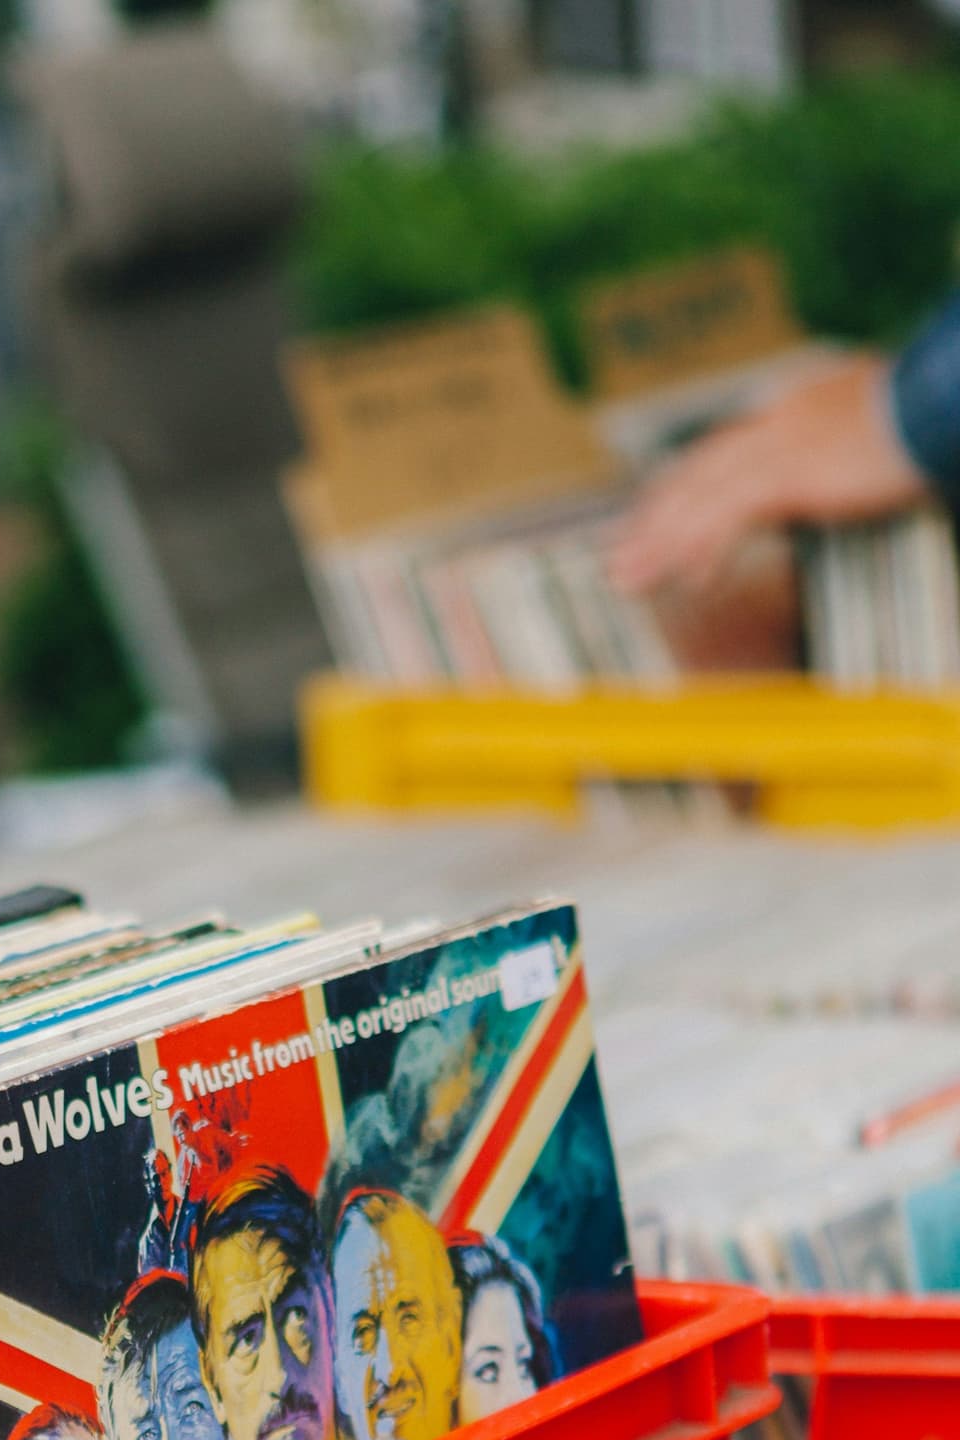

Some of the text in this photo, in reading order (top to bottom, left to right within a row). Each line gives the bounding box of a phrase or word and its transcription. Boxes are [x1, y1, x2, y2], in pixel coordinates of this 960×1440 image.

[178, 1048, 254, 1102] Music
[252, 1034, 317, 1076] from
[313, 1014, 357, 1056] the
[356, 976, 450, 1039] original
[22, 1068, 175, 1155] Wolves
